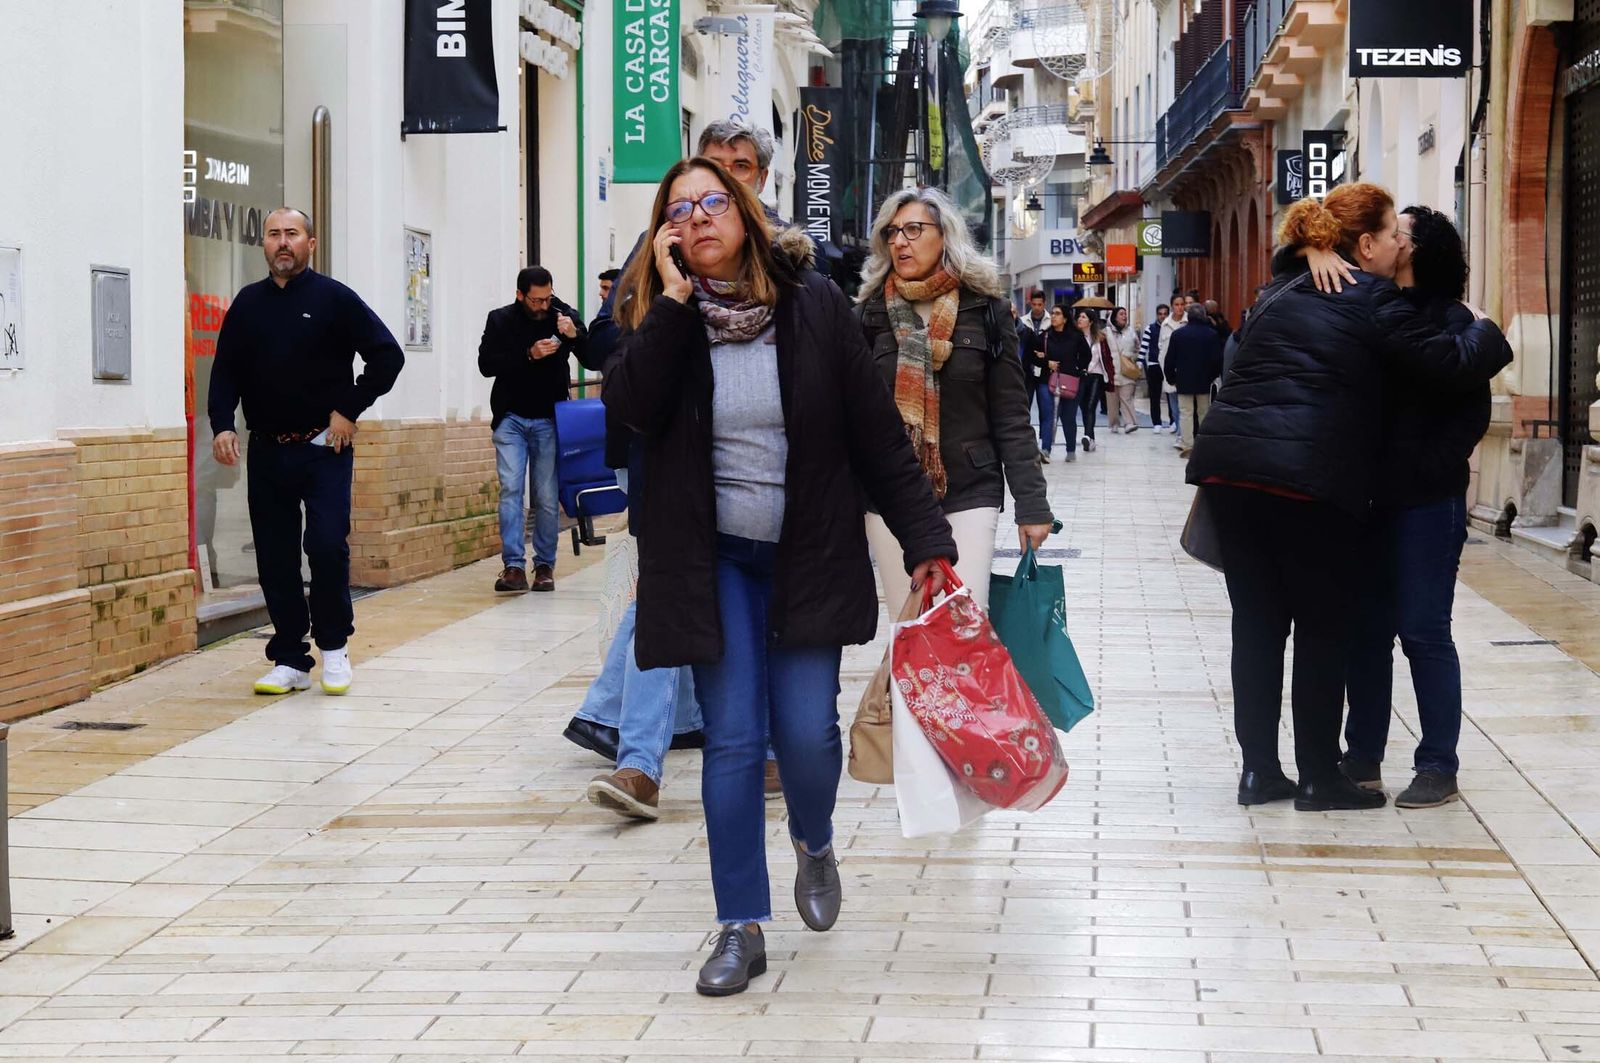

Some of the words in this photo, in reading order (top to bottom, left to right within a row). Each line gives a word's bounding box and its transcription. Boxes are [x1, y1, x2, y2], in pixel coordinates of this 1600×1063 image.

[625, 18, 646, 93] CASA
[1355, 44, 1462, 66] TEZENiS
[625, 103, 645, 144] LA
[801, 104, 834, 162] Dulce
[223, 202, 235, 242] Y
[239, 205, 266, 246] LOL
[1051, 238, 1085, 255] BBV
